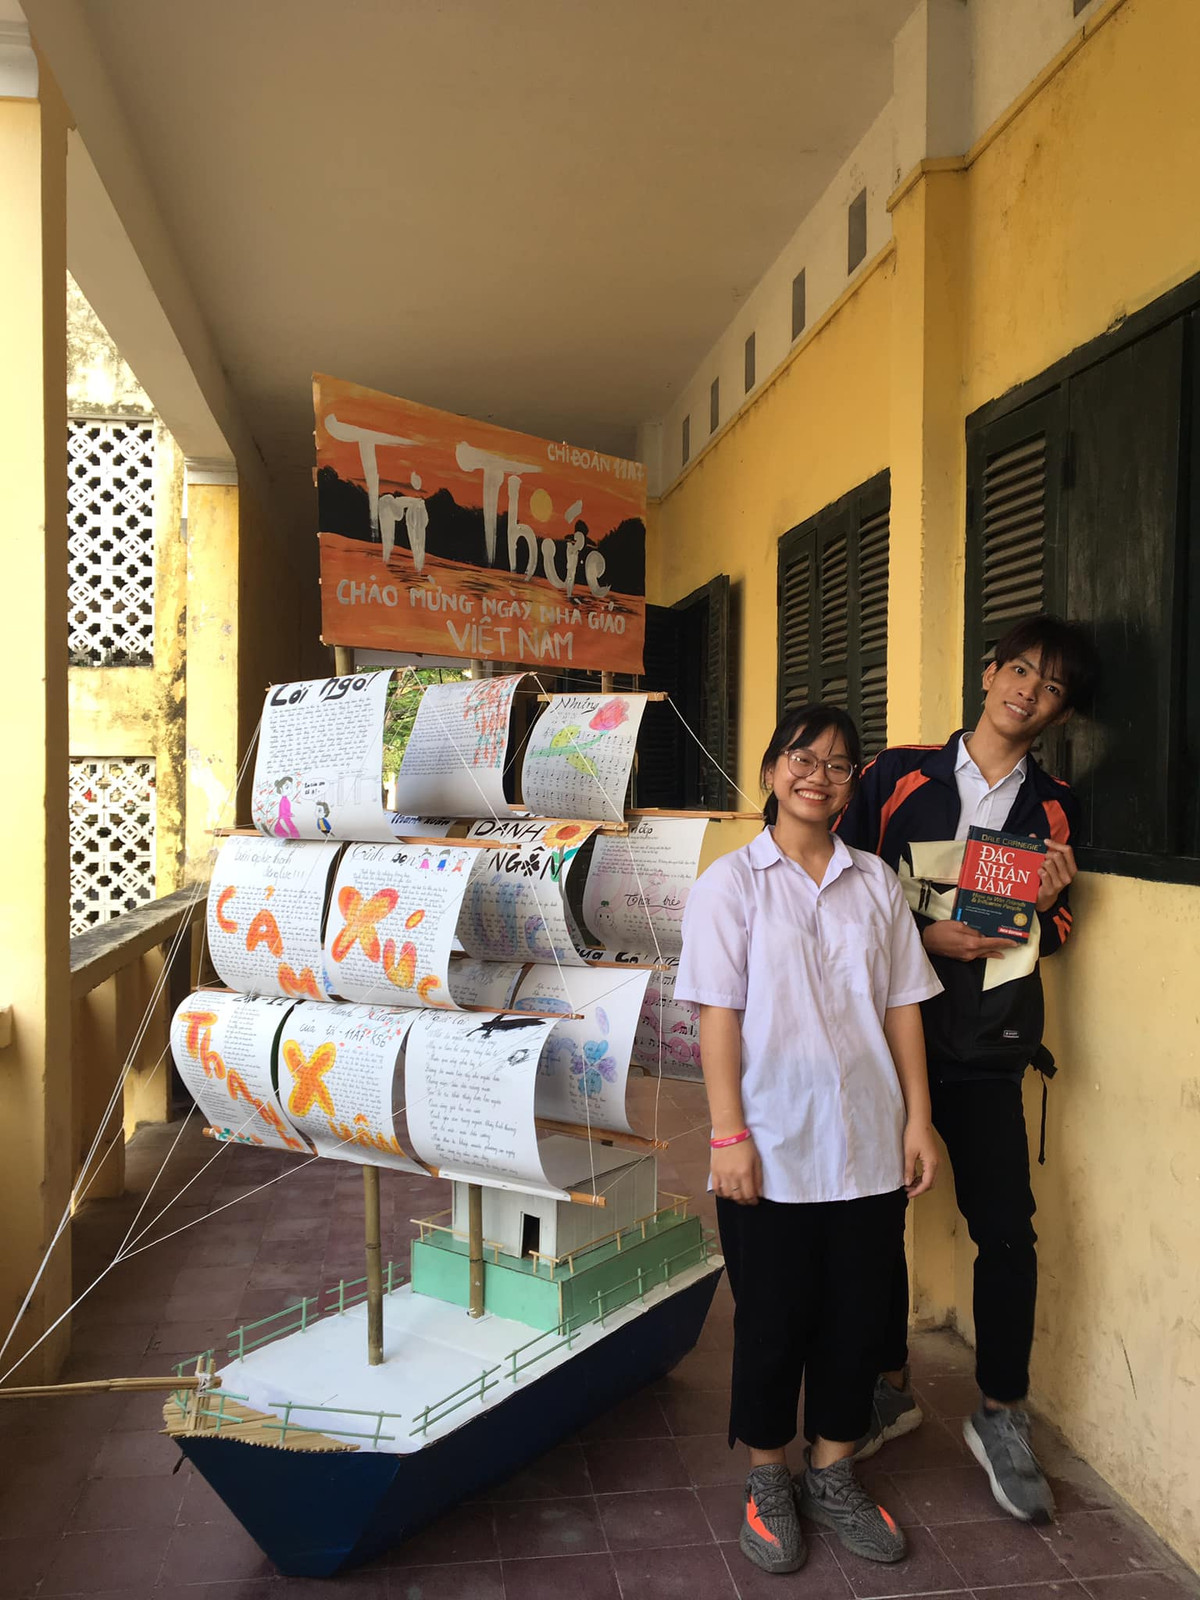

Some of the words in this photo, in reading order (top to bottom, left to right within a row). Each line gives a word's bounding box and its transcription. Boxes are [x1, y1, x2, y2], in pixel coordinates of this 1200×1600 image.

[455, 440, 612, 598] Thức
[337, 575, 398, 607] CHÀO
[409, 574, 475, 614] MỪNG
[482, 589, 533, 620] NGÀY
[540, 598, 583, 625] NHÀ
[446, 616, 512, 660] VIỆT
[518, 627, 573, 660] NAM
[474, 820, 546, 842] DANH
